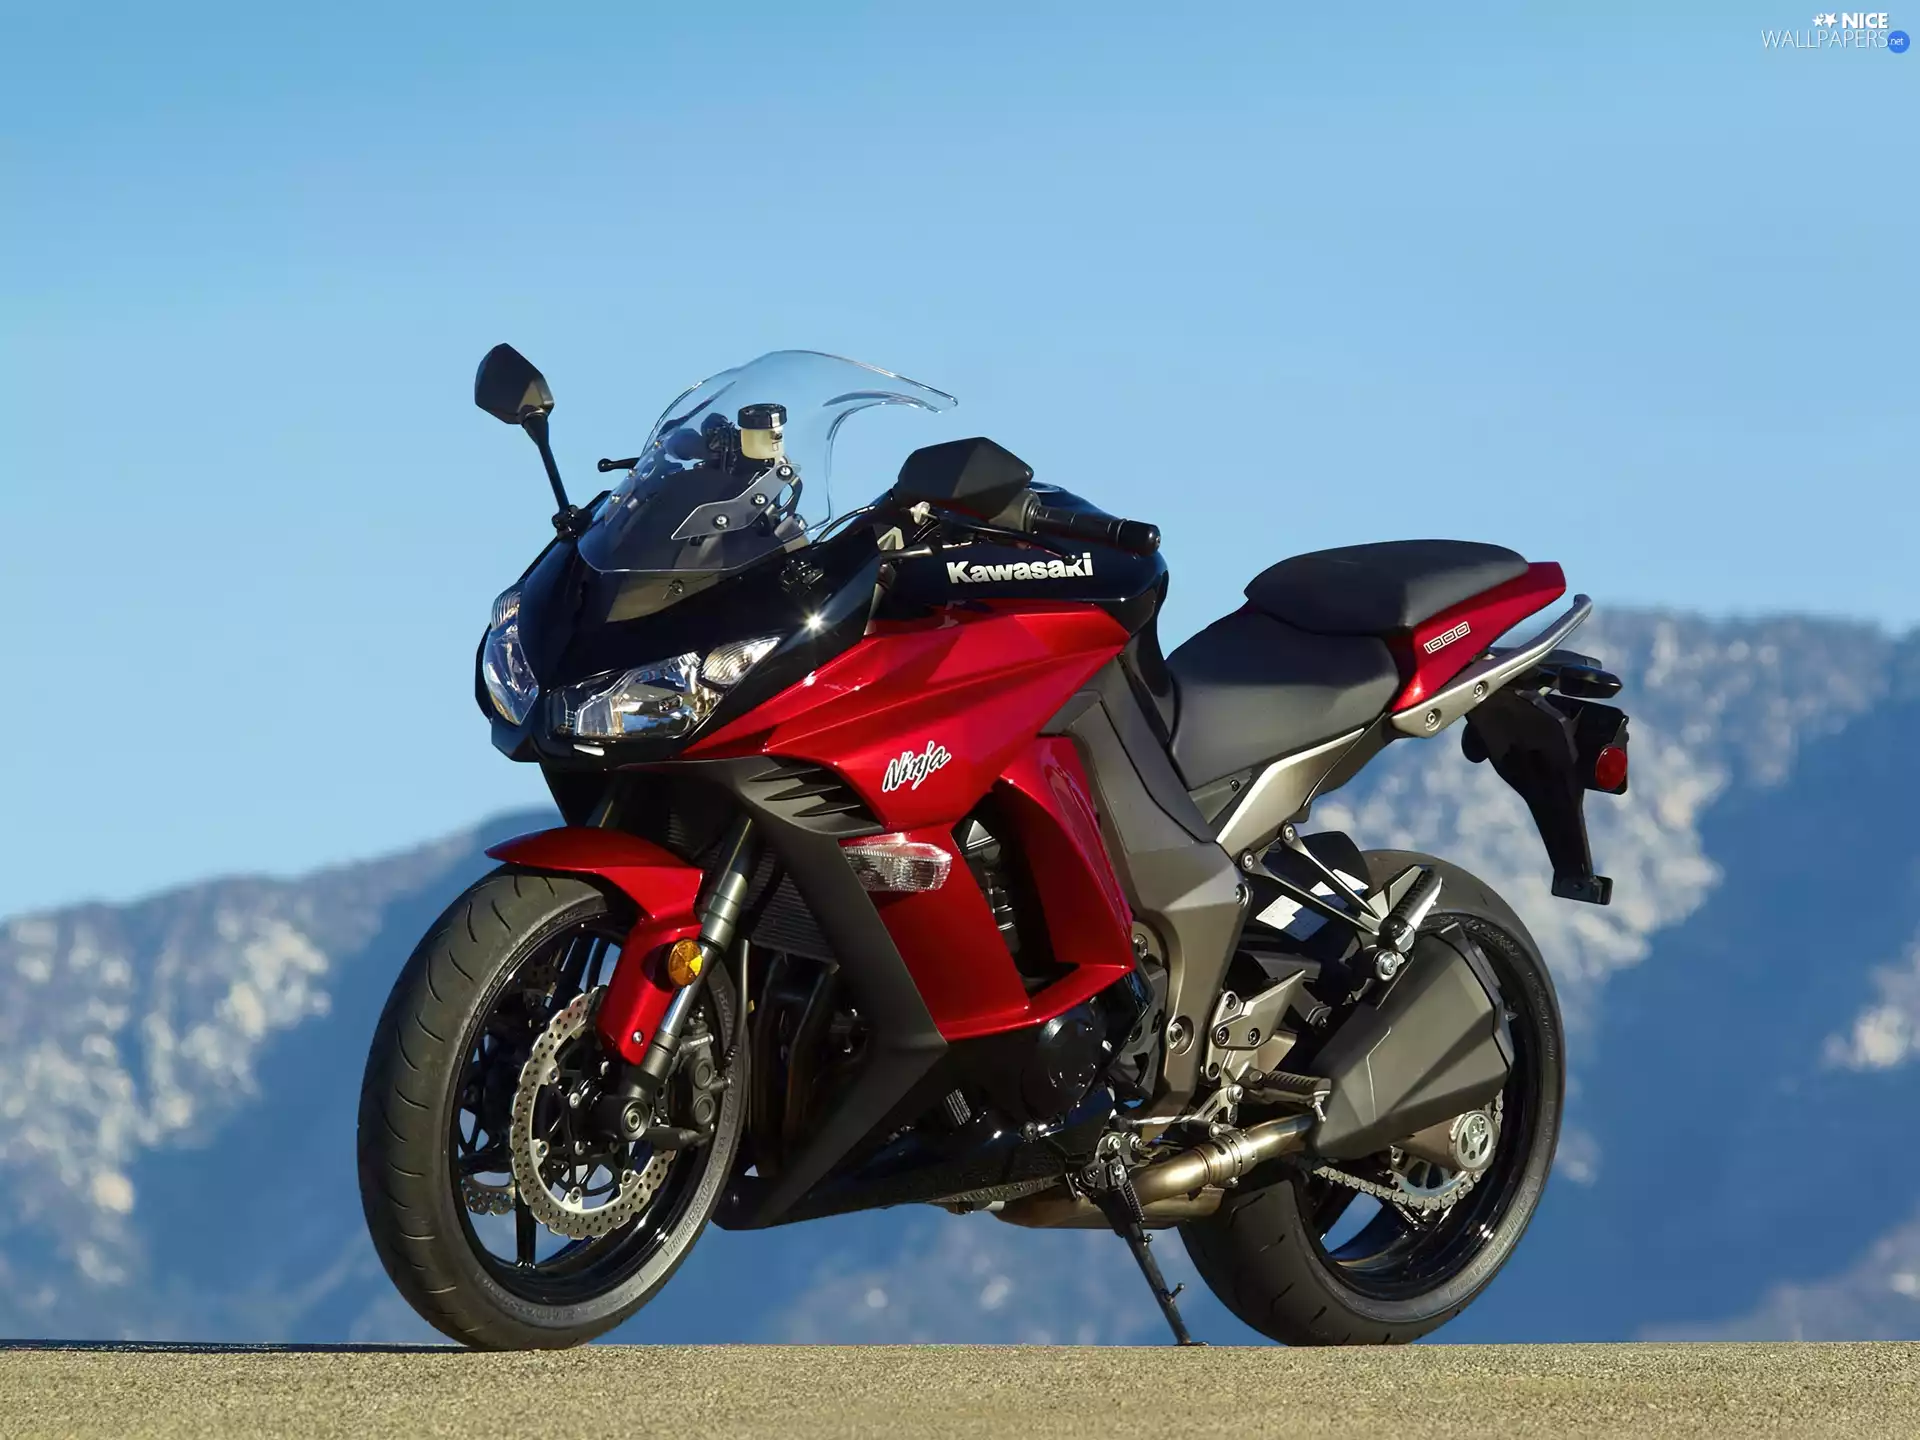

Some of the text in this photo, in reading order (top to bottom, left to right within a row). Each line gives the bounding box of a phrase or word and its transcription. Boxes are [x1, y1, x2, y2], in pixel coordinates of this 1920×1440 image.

[946, 552, 1093, 583] Kawasaki
[1423, 621, 1471, 654] 1000
[882, 740, 951, 792] Ninja
